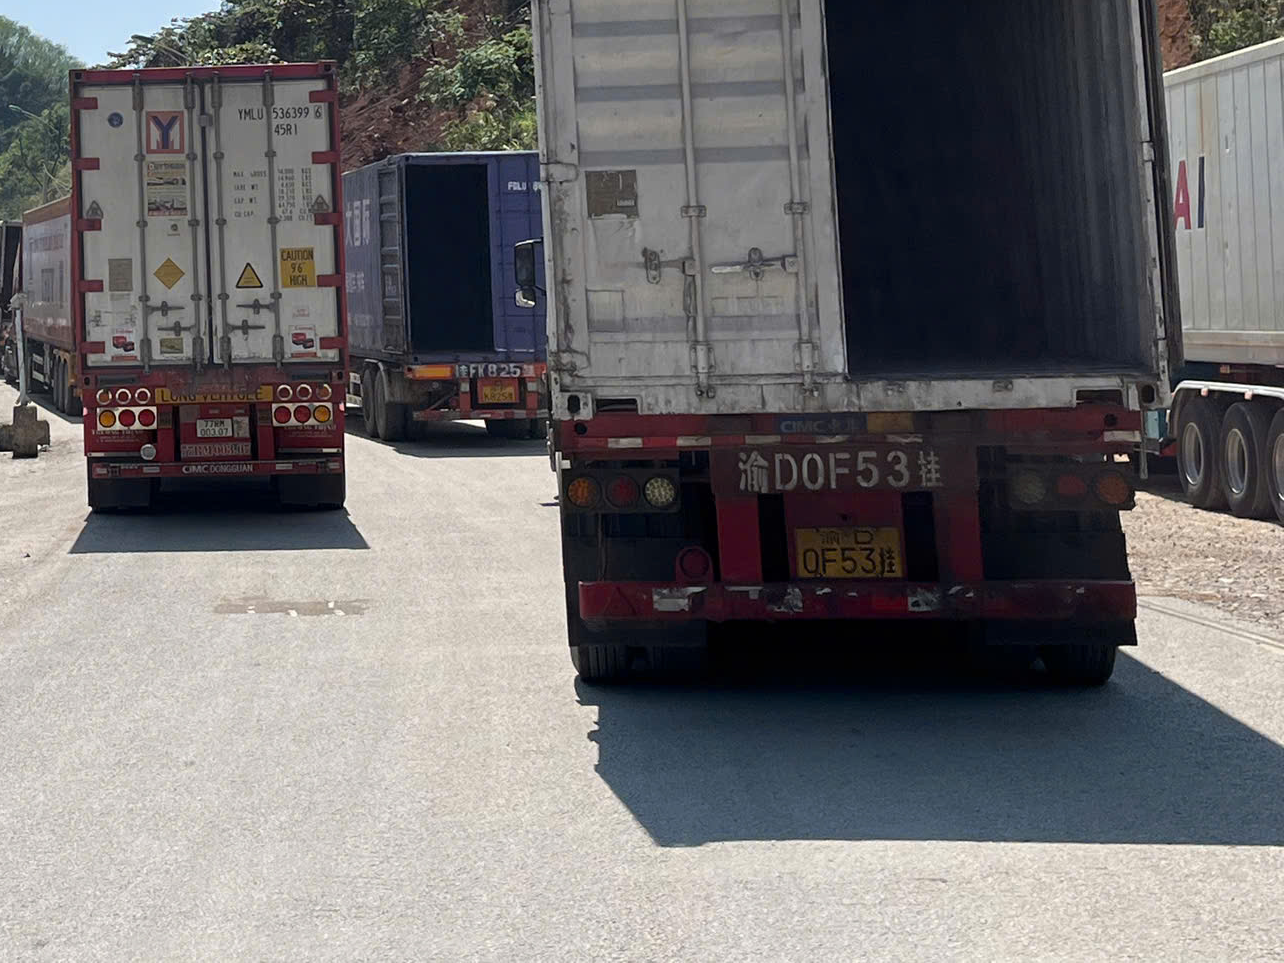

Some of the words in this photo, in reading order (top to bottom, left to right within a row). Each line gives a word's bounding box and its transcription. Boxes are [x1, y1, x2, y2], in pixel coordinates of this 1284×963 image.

[237, 108, 264, 120] YMLU
[272, 106, 310, 120] 536399
[315, 106, 322, 118] 6
[281, 249, 314, 261] CAUTION
[289, 274, 308, 286] HIGH
[182, 464, 209, 474] CIMC
[210, 464, 253, 473] DONGGUAN
